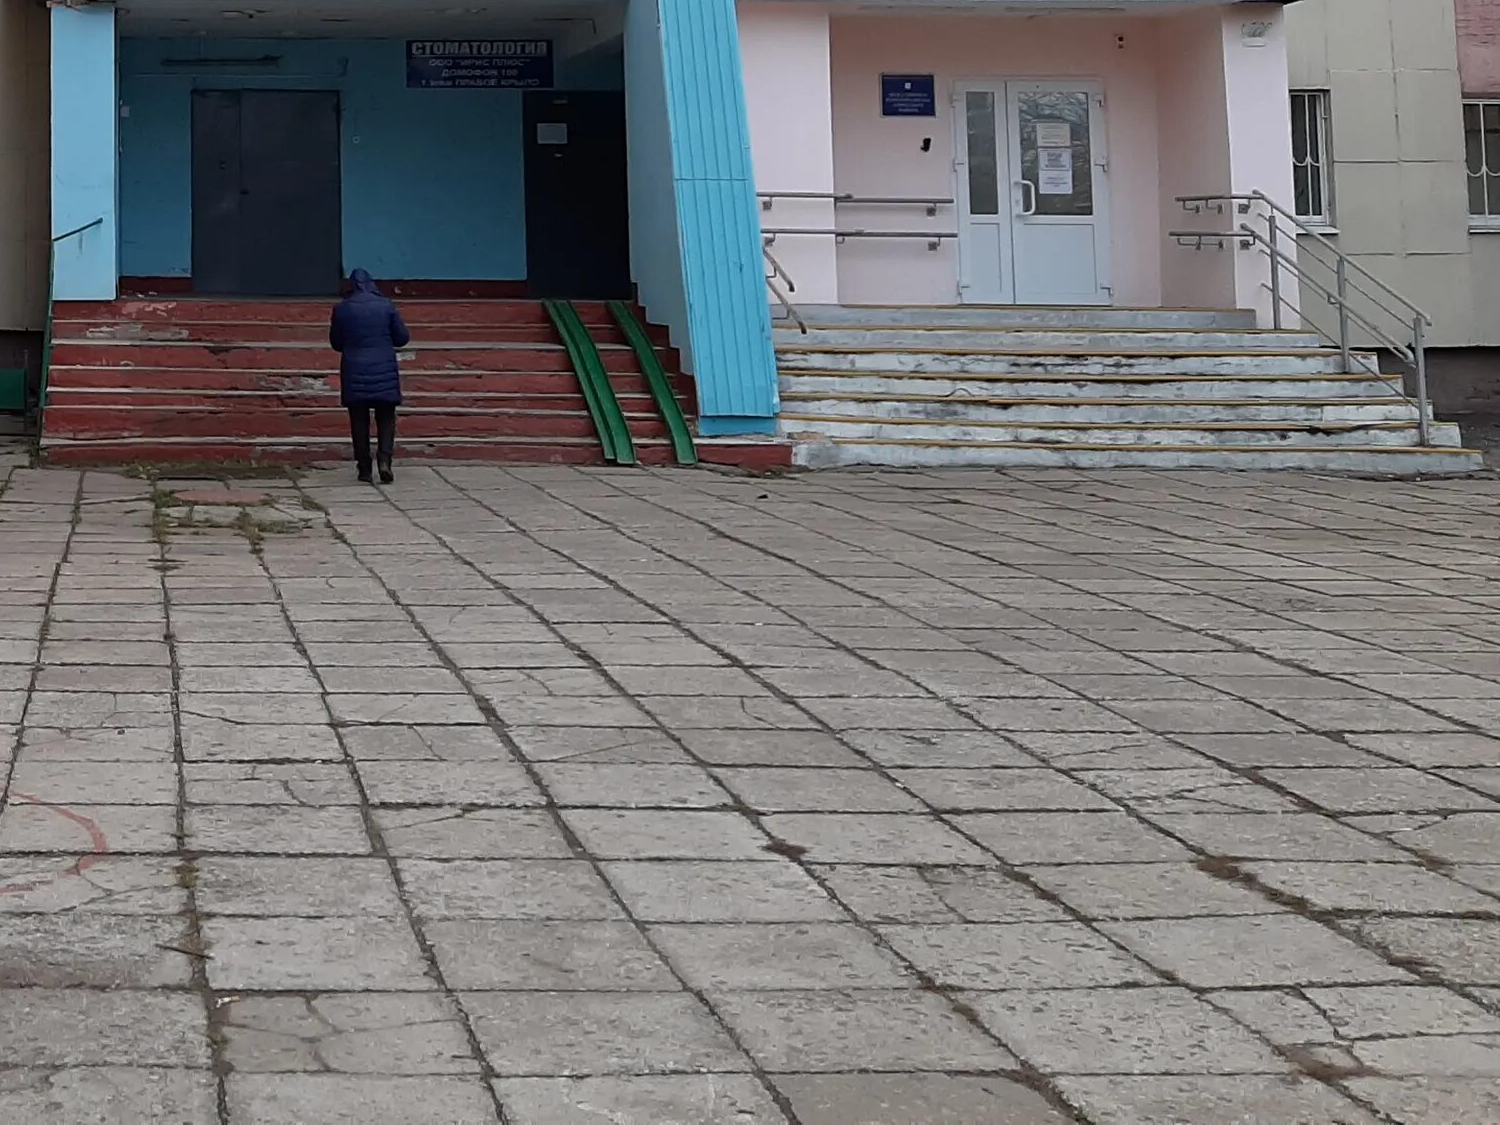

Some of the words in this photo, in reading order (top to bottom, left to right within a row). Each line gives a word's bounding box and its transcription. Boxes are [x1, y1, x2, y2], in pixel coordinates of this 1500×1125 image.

[411, 41, 548, 55] СТОМАТОЛОГИЯ
[428, 58, 453, 66] ООО
[441, 69, 498, 77] ДОМОФОН
